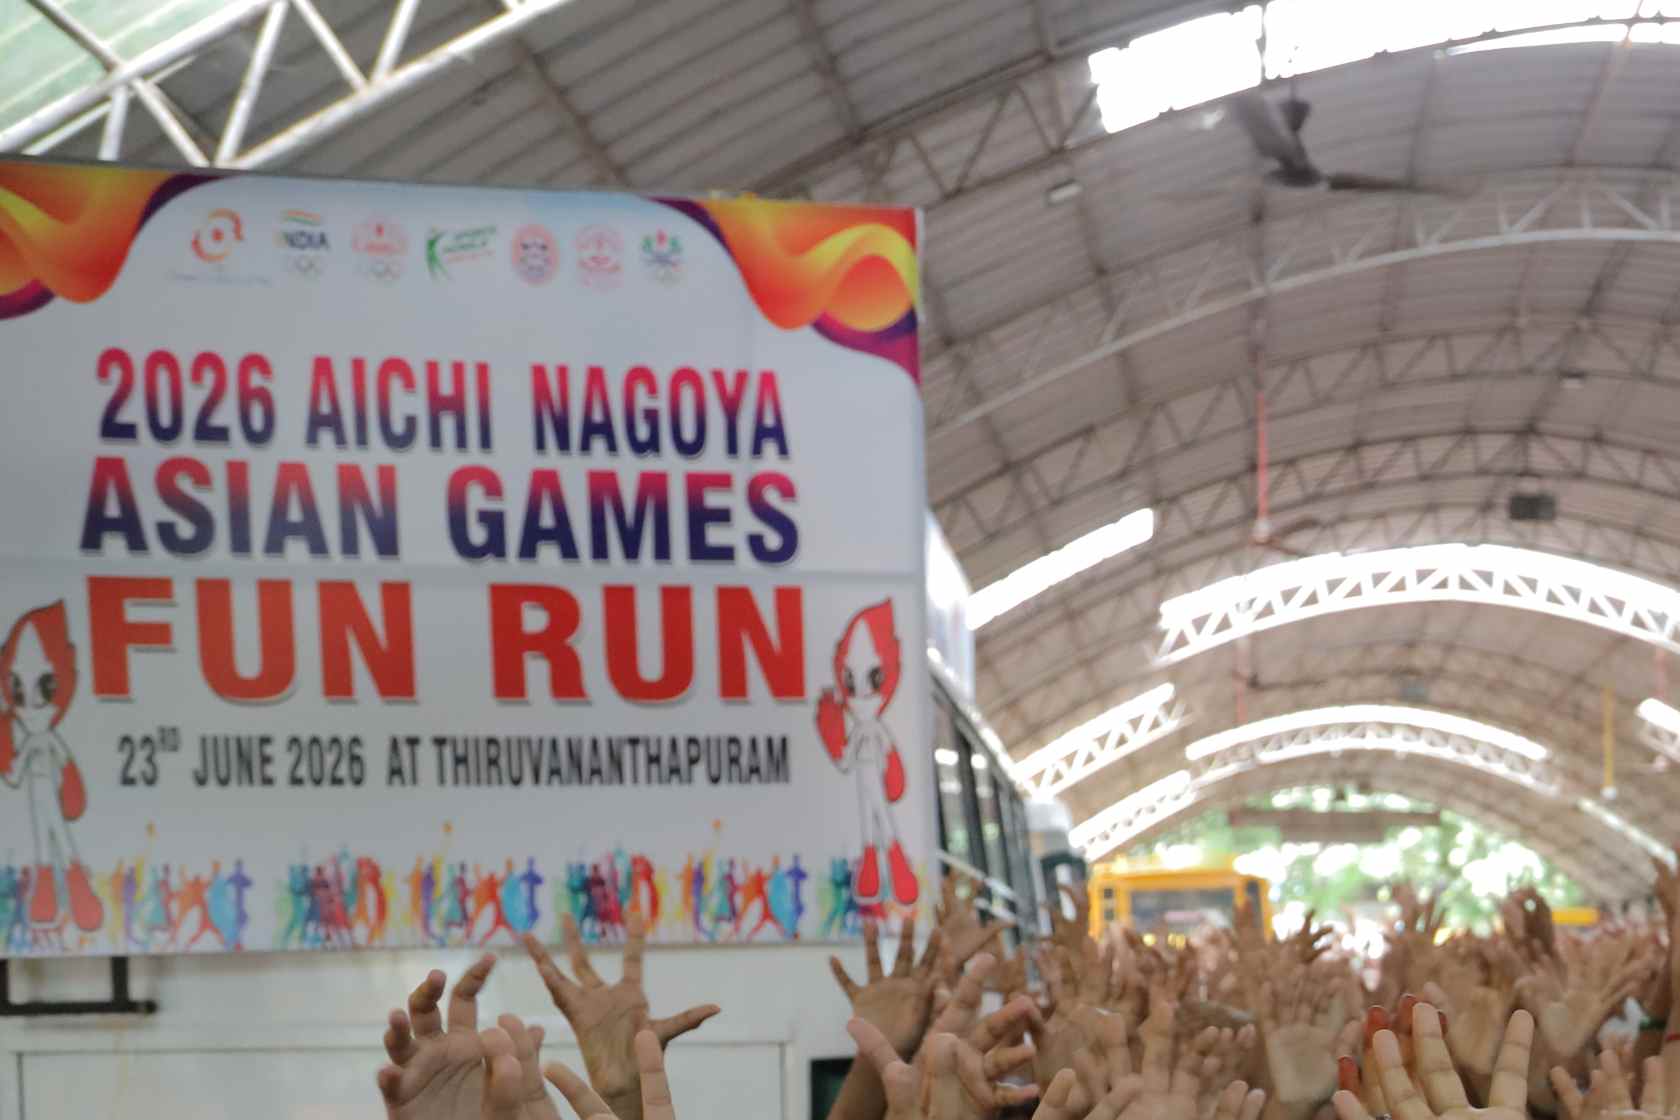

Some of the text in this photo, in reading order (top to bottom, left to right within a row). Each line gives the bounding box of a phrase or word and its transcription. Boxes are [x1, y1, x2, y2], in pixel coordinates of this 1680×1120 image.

[96, 347, 789, 457] 2026 AICHI NAGOYA
[79, 456, 799, 564] ASIAN GAMES
[86, 575, 807, 704] FUN RUN
[193, 735, 275, 787] JUNE
[287, 735, 364, 787] 2026
[386, 735, 421, 787] AT
[433, 735, 791, 786] THIRUVANANTHAPURAM
